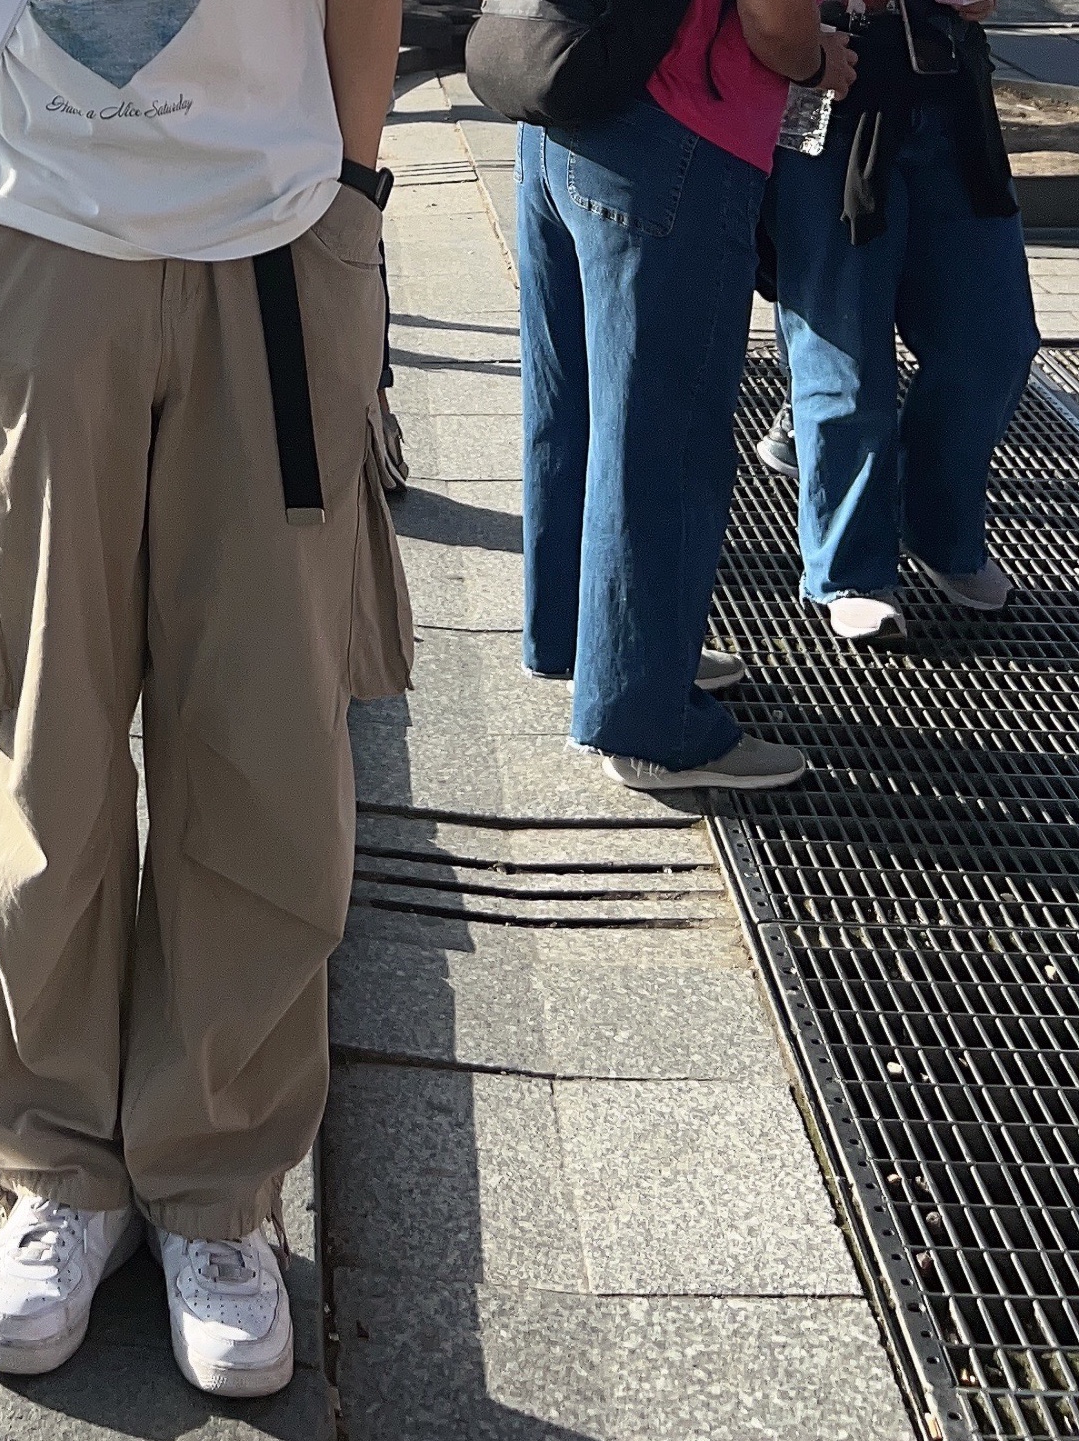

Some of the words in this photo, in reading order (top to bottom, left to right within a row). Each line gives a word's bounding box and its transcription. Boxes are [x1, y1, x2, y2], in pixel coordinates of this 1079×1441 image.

[86, 109, 95, 119] a
[99, 101, 141, 120] Nice
[144, 93, 193, 118] Saturday
